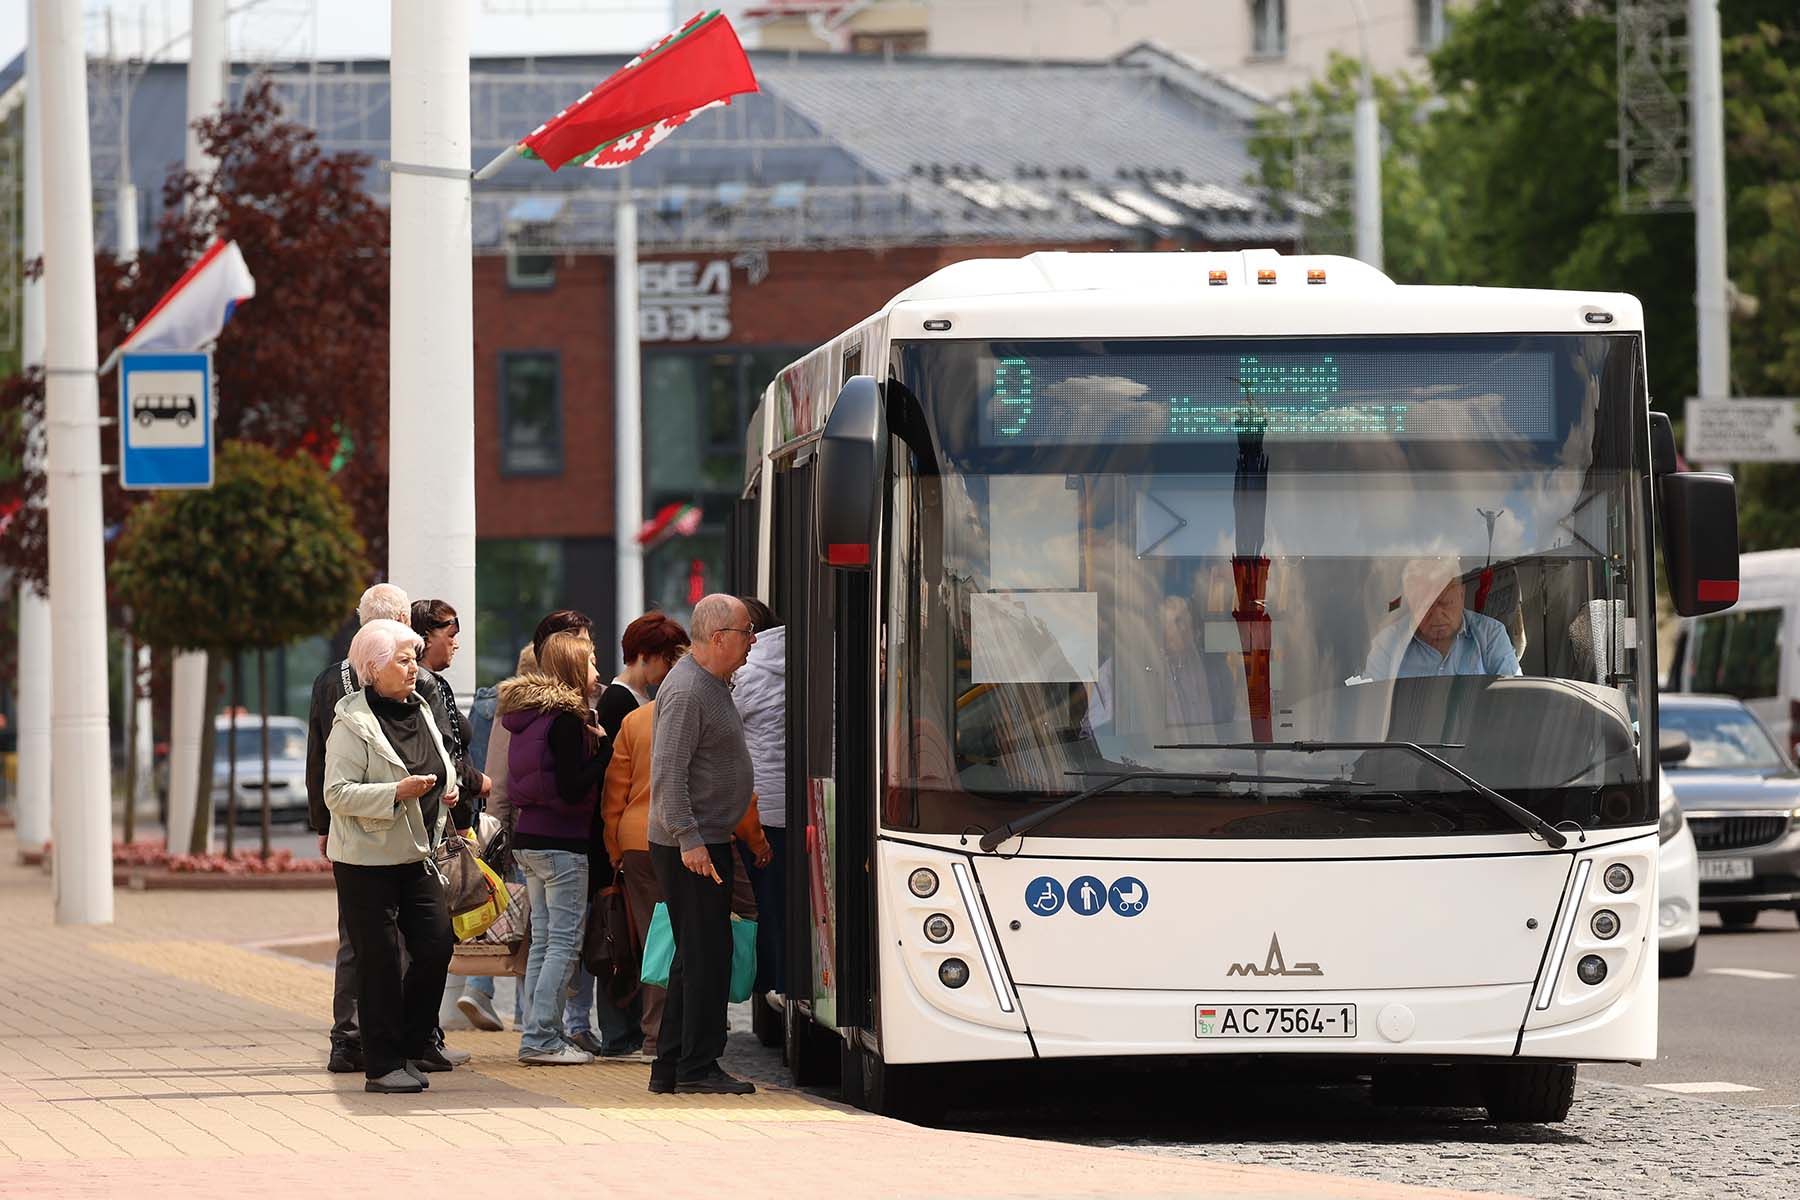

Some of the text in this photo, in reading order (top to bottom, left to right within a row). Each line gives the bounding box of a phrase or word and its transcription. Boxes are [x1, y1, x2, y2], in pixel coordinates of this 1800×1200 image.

[638, 261, 731, 295] БЕЛ
[639, 306, 731, 341] ВЭБ
[995, 358, 1032, 434] 9
[1200, 1023, 1215, 1034] BY
